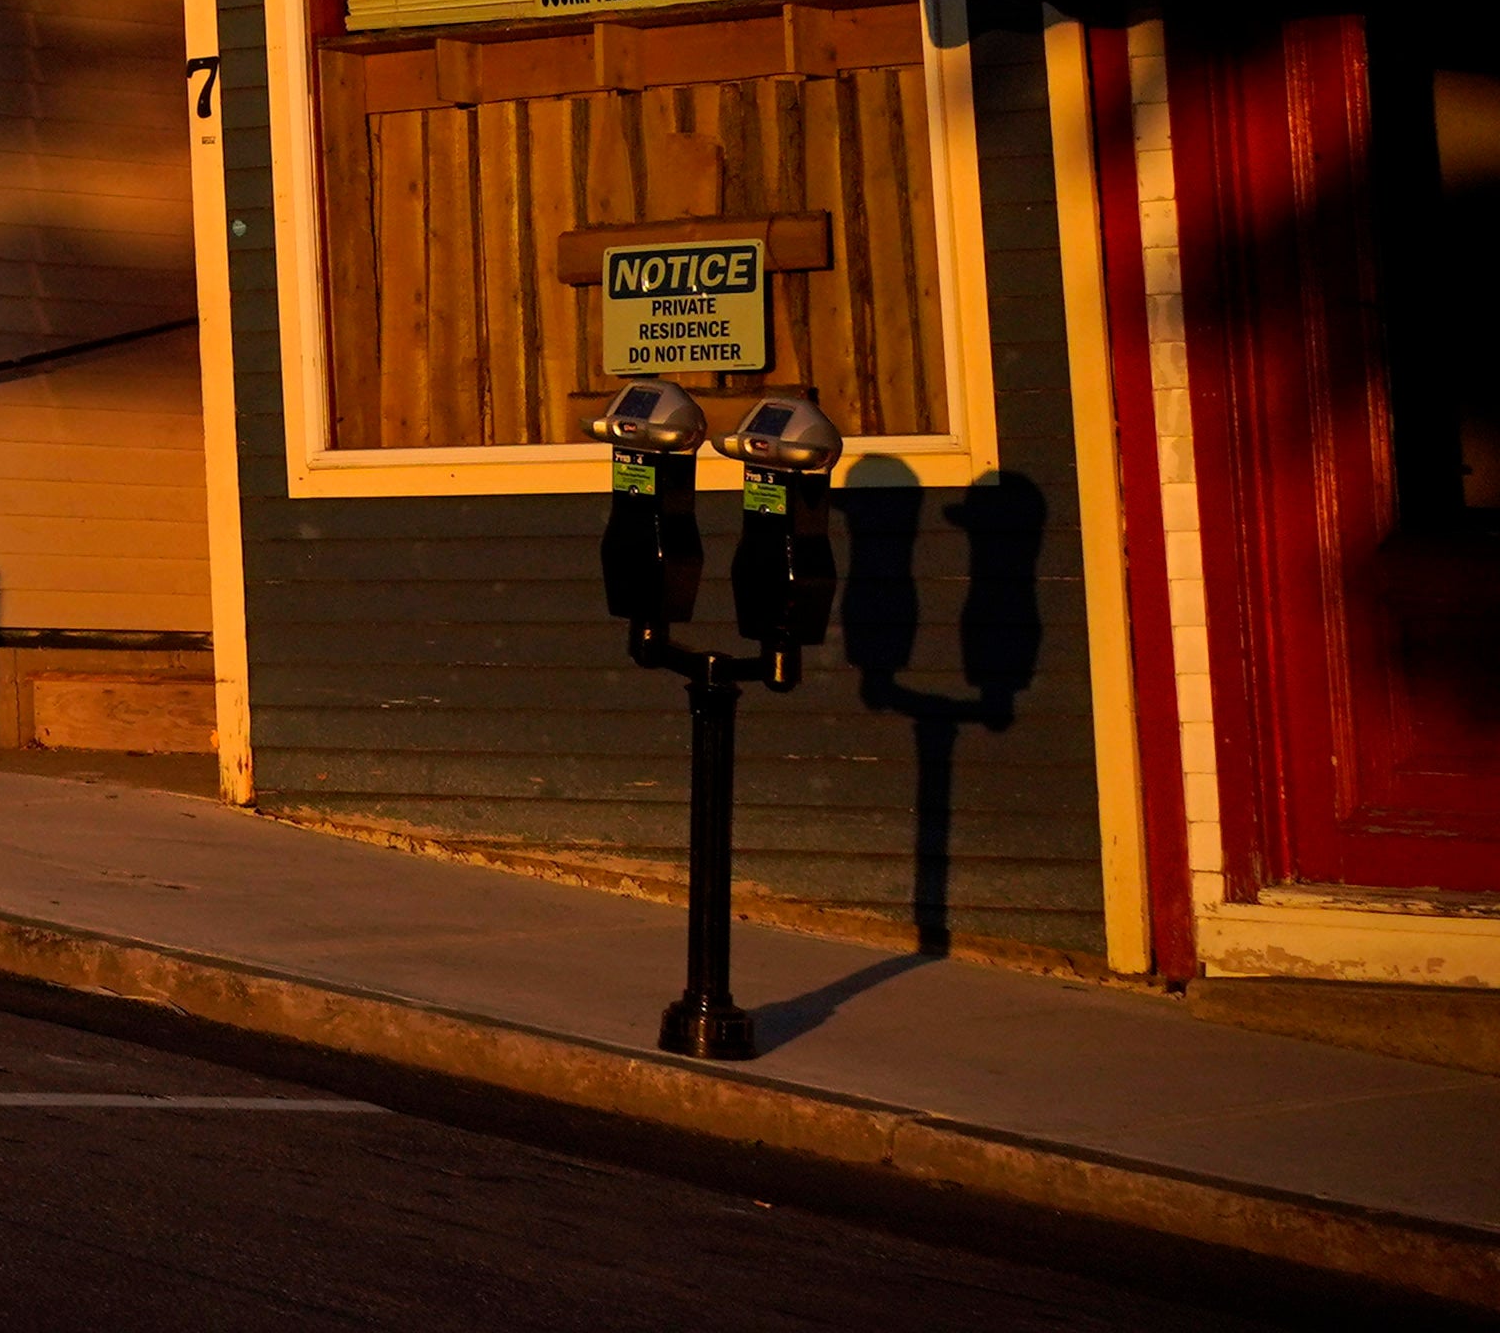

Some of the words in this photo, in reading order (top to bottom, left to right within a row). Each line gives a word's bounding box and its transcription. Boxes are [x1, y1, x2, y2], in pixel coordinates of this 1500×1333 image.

[186, 56, 221, 120] 7
[613, 251, 753, 293] NOTICE
[651, 297, 717, 317] PRIVATE
[639, 320, 731, 340] RESIDENCE
[628, 346, 651, 364] DO
[655, 345, 686, 363] NOT
[690, 343, 741, 361] ENTER
